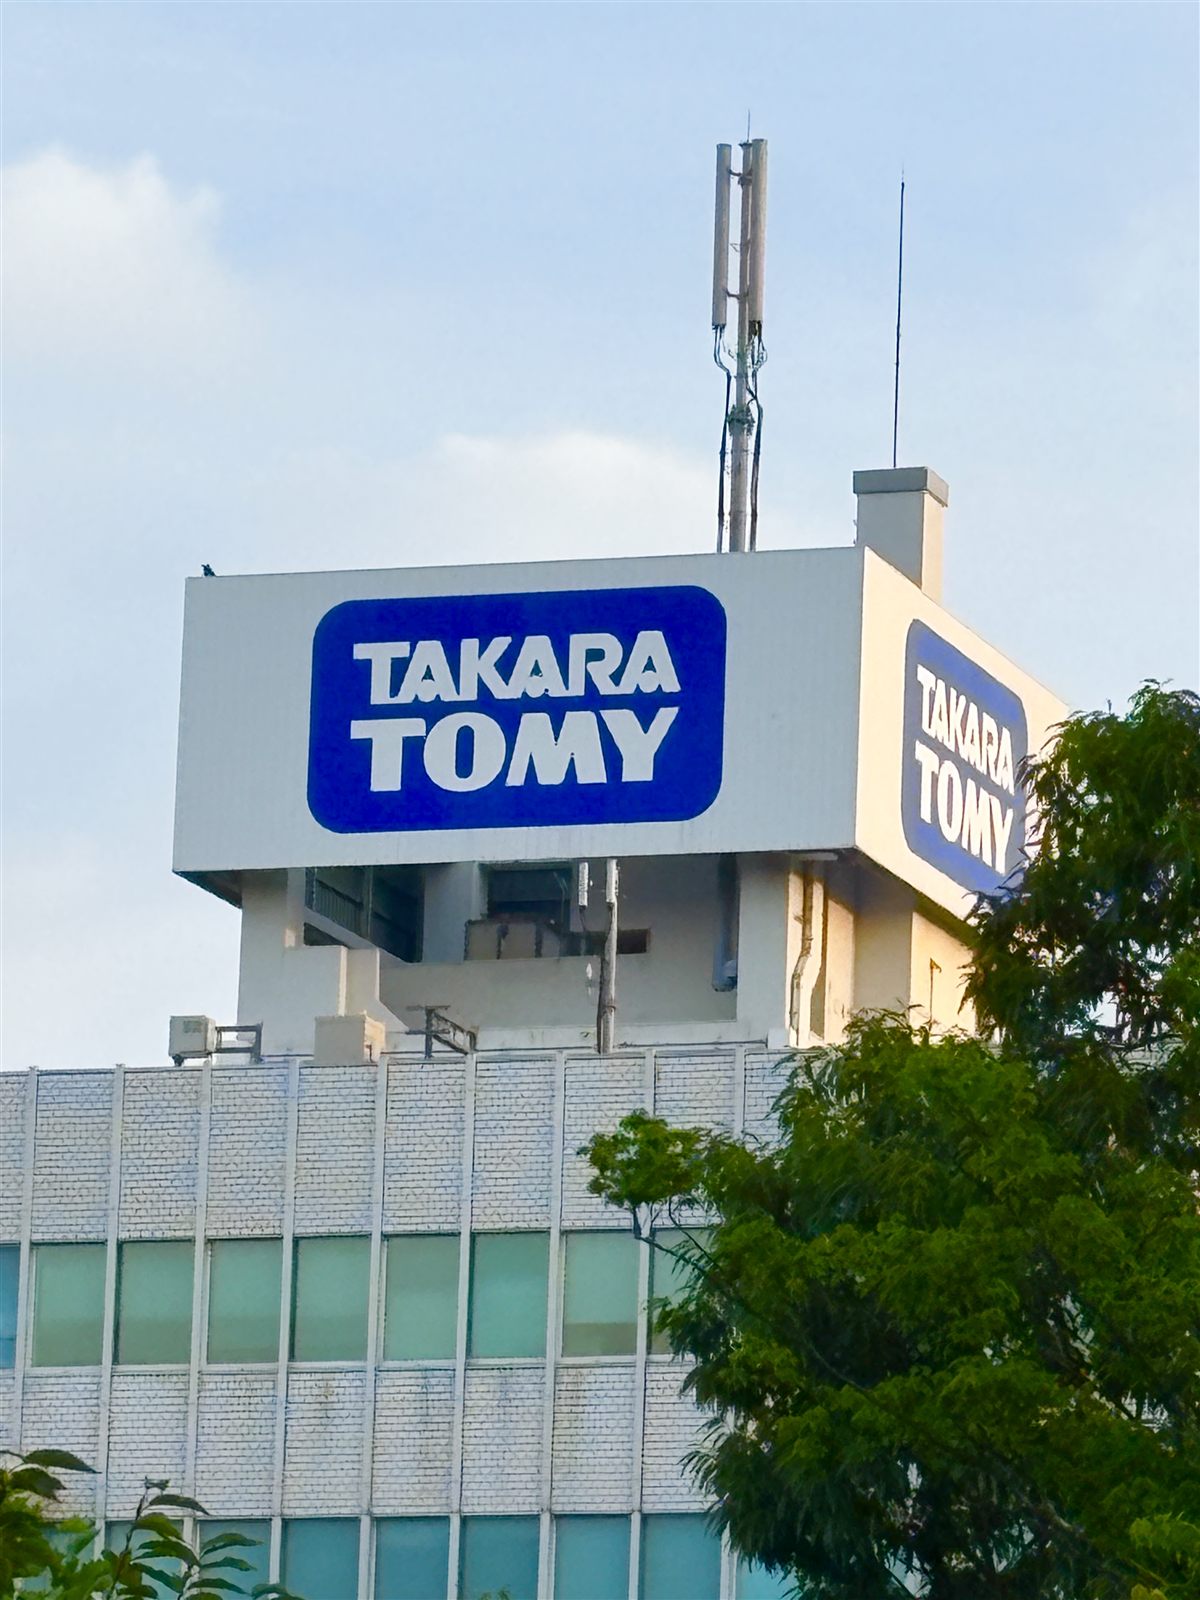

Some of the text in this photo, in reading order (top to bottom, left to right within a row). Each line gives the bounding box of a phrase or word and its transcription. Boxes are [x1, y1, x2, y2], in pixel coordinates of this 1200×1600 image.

[351, 629, 681, 706] TAKARA
[349, 705, 681, 793] TOMY
[916, 663, 1015, 796] TAKARA
[914, 739, 1014, 876] TOMY
